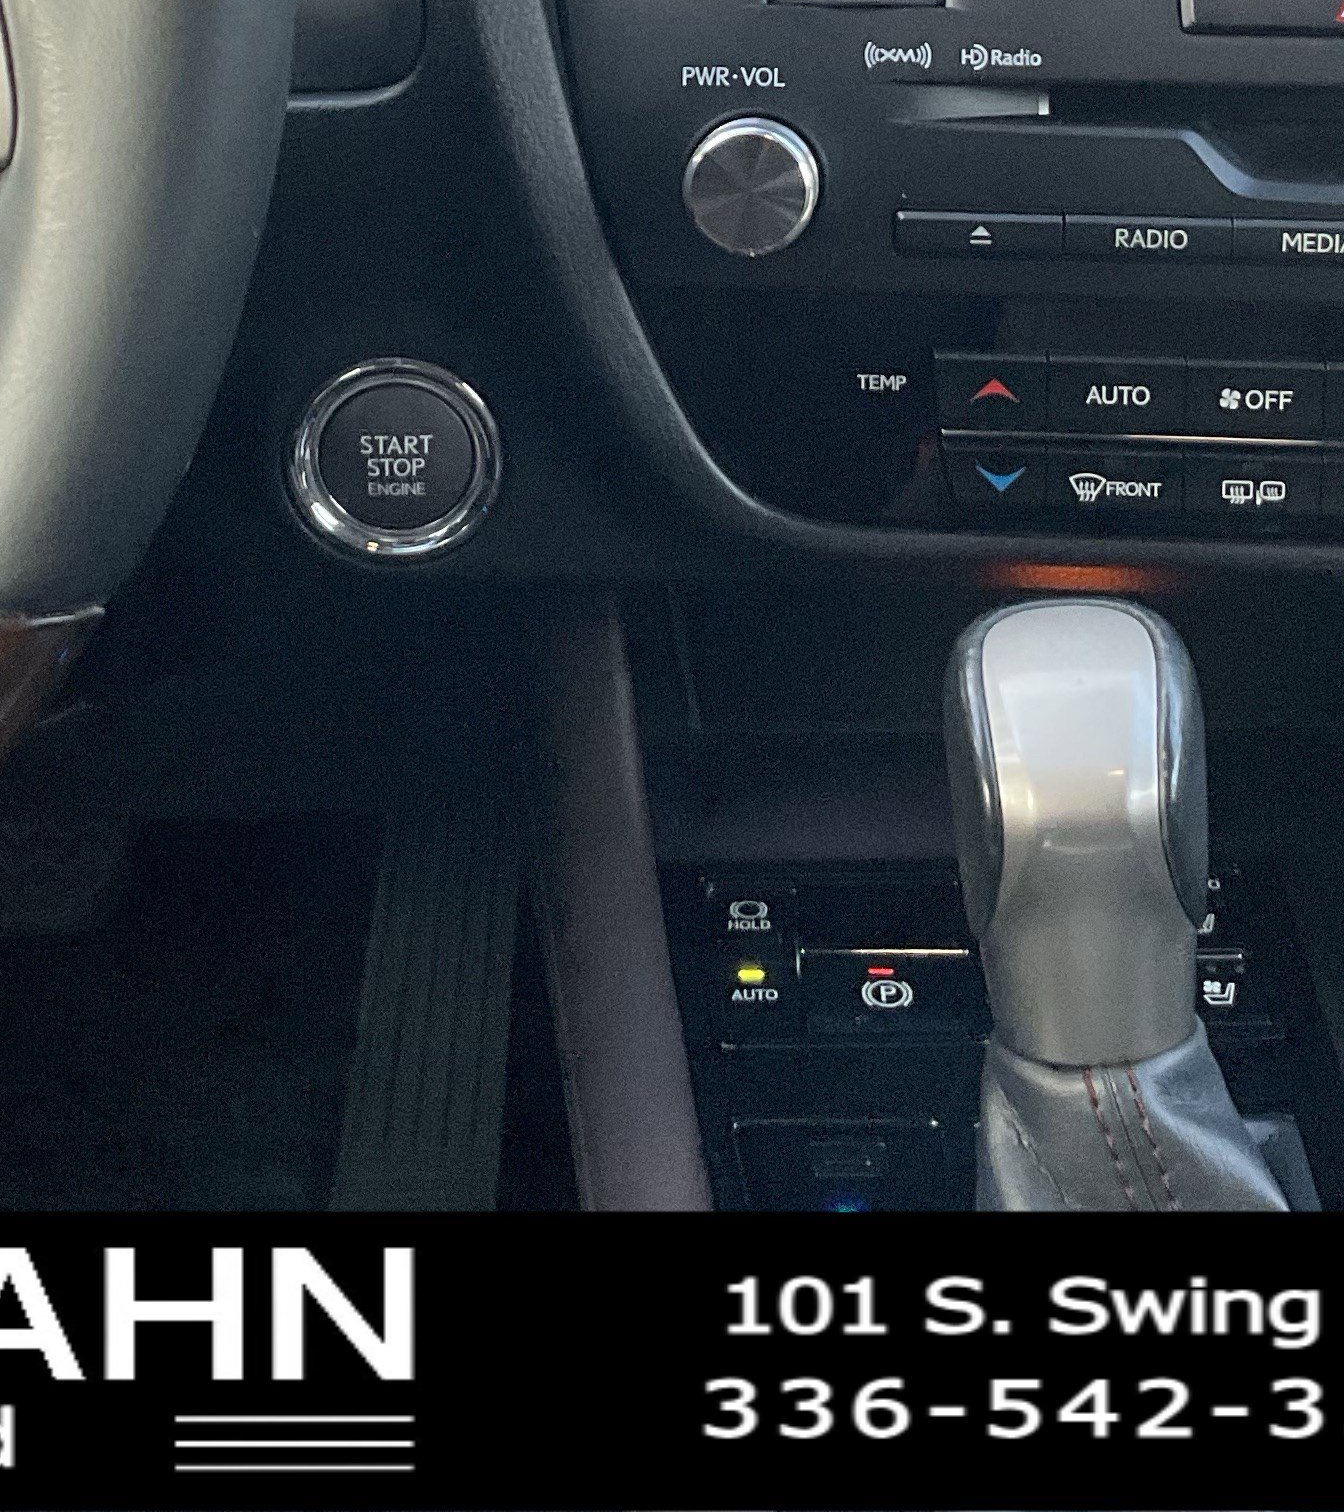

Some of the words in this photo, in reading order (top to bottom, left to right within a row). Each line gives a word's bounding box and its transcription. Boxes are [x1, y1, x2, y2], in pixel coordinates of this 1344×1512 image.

[990, 48, 1042, 67] Radio
[1115, 228, 1188, 250] RADIO
[856, 373, 907, 392] TEMP
[1085, 385, 1151, 406] AUTO
[1244, 389, 1294, 411] OFF
[360, 434, 434, 455] START
[367, 457, 426, 477] STOP
[367, 481, 425, 496] ENGINE
[1106, 480, 1162, 498] FRONT
[727, 919, 771, 931] HOLD
[731, 988, 779, 1001] AUTO
